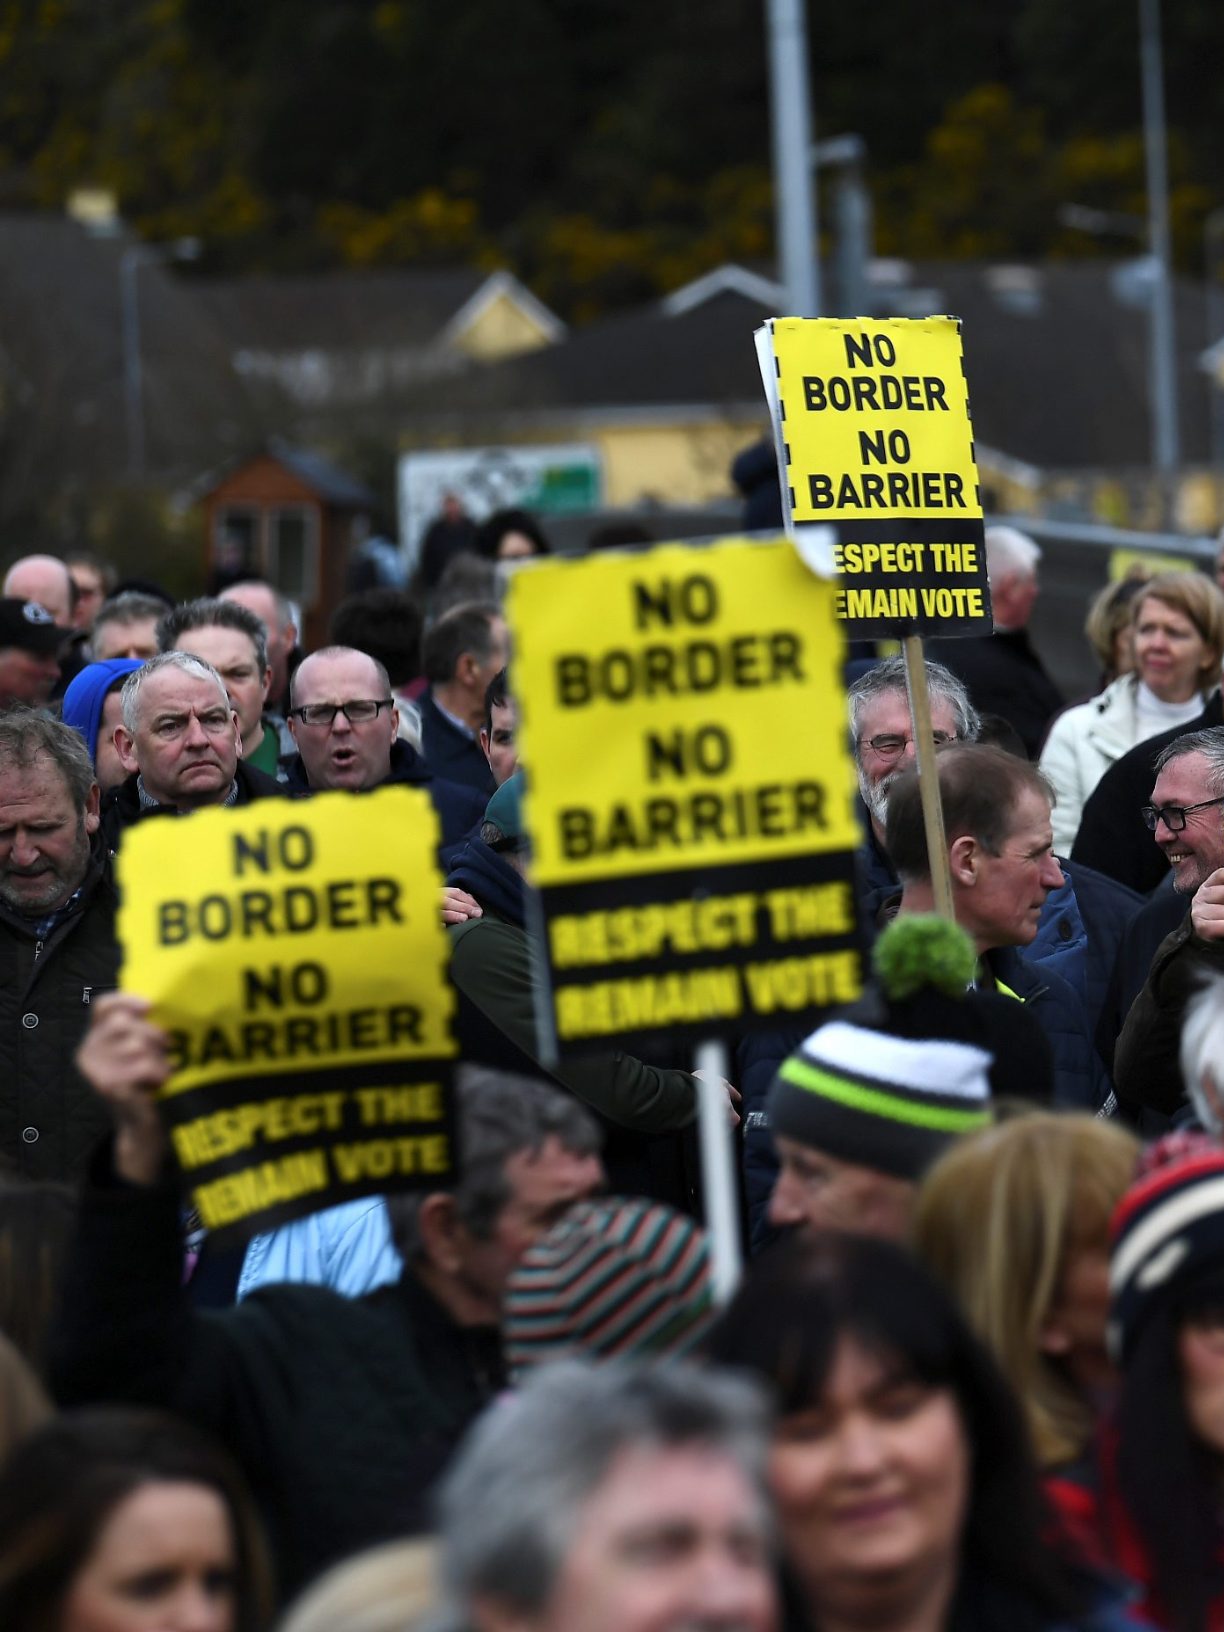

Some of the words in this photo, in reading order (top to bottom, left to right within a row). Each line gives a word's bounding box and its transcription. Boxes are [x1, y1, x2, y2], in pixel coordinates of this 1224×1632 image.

[843, 333, 897, 369] NO
[802, 375, 950, 411] BORDER
[858, 429, 910, 465] NO
[807, 473, 967, 509] BARRIER
[831, 543, 925, 573] ESPECT
[929, 543, 978, 573] THE
[634, 576, 719, 630] NO
[834, 588, 918, 618] EMAIN
[921, 588, 984, 618] VOTE
[555, 632, 804, 708] BORDER
[645, 724, 733, 781] NO
[559, 781, 827, 860] BARRIER
[232, 826, 315, 877] NO
[157, 877, 404, 946] BORDER
[551, 895, 758, 967] RESPECT
[766, 883, 853, 937] THE
[242, 962, 329, 1011] NO
[555, 967, 739, 1039] REMAIN
[746, 952, 863, 1011] VOTE
[167, 1006, 424, 1069] BARRIER
[357, 1082, 443, 1124] THE
[333, 1135, 449, 1184] VOTE
